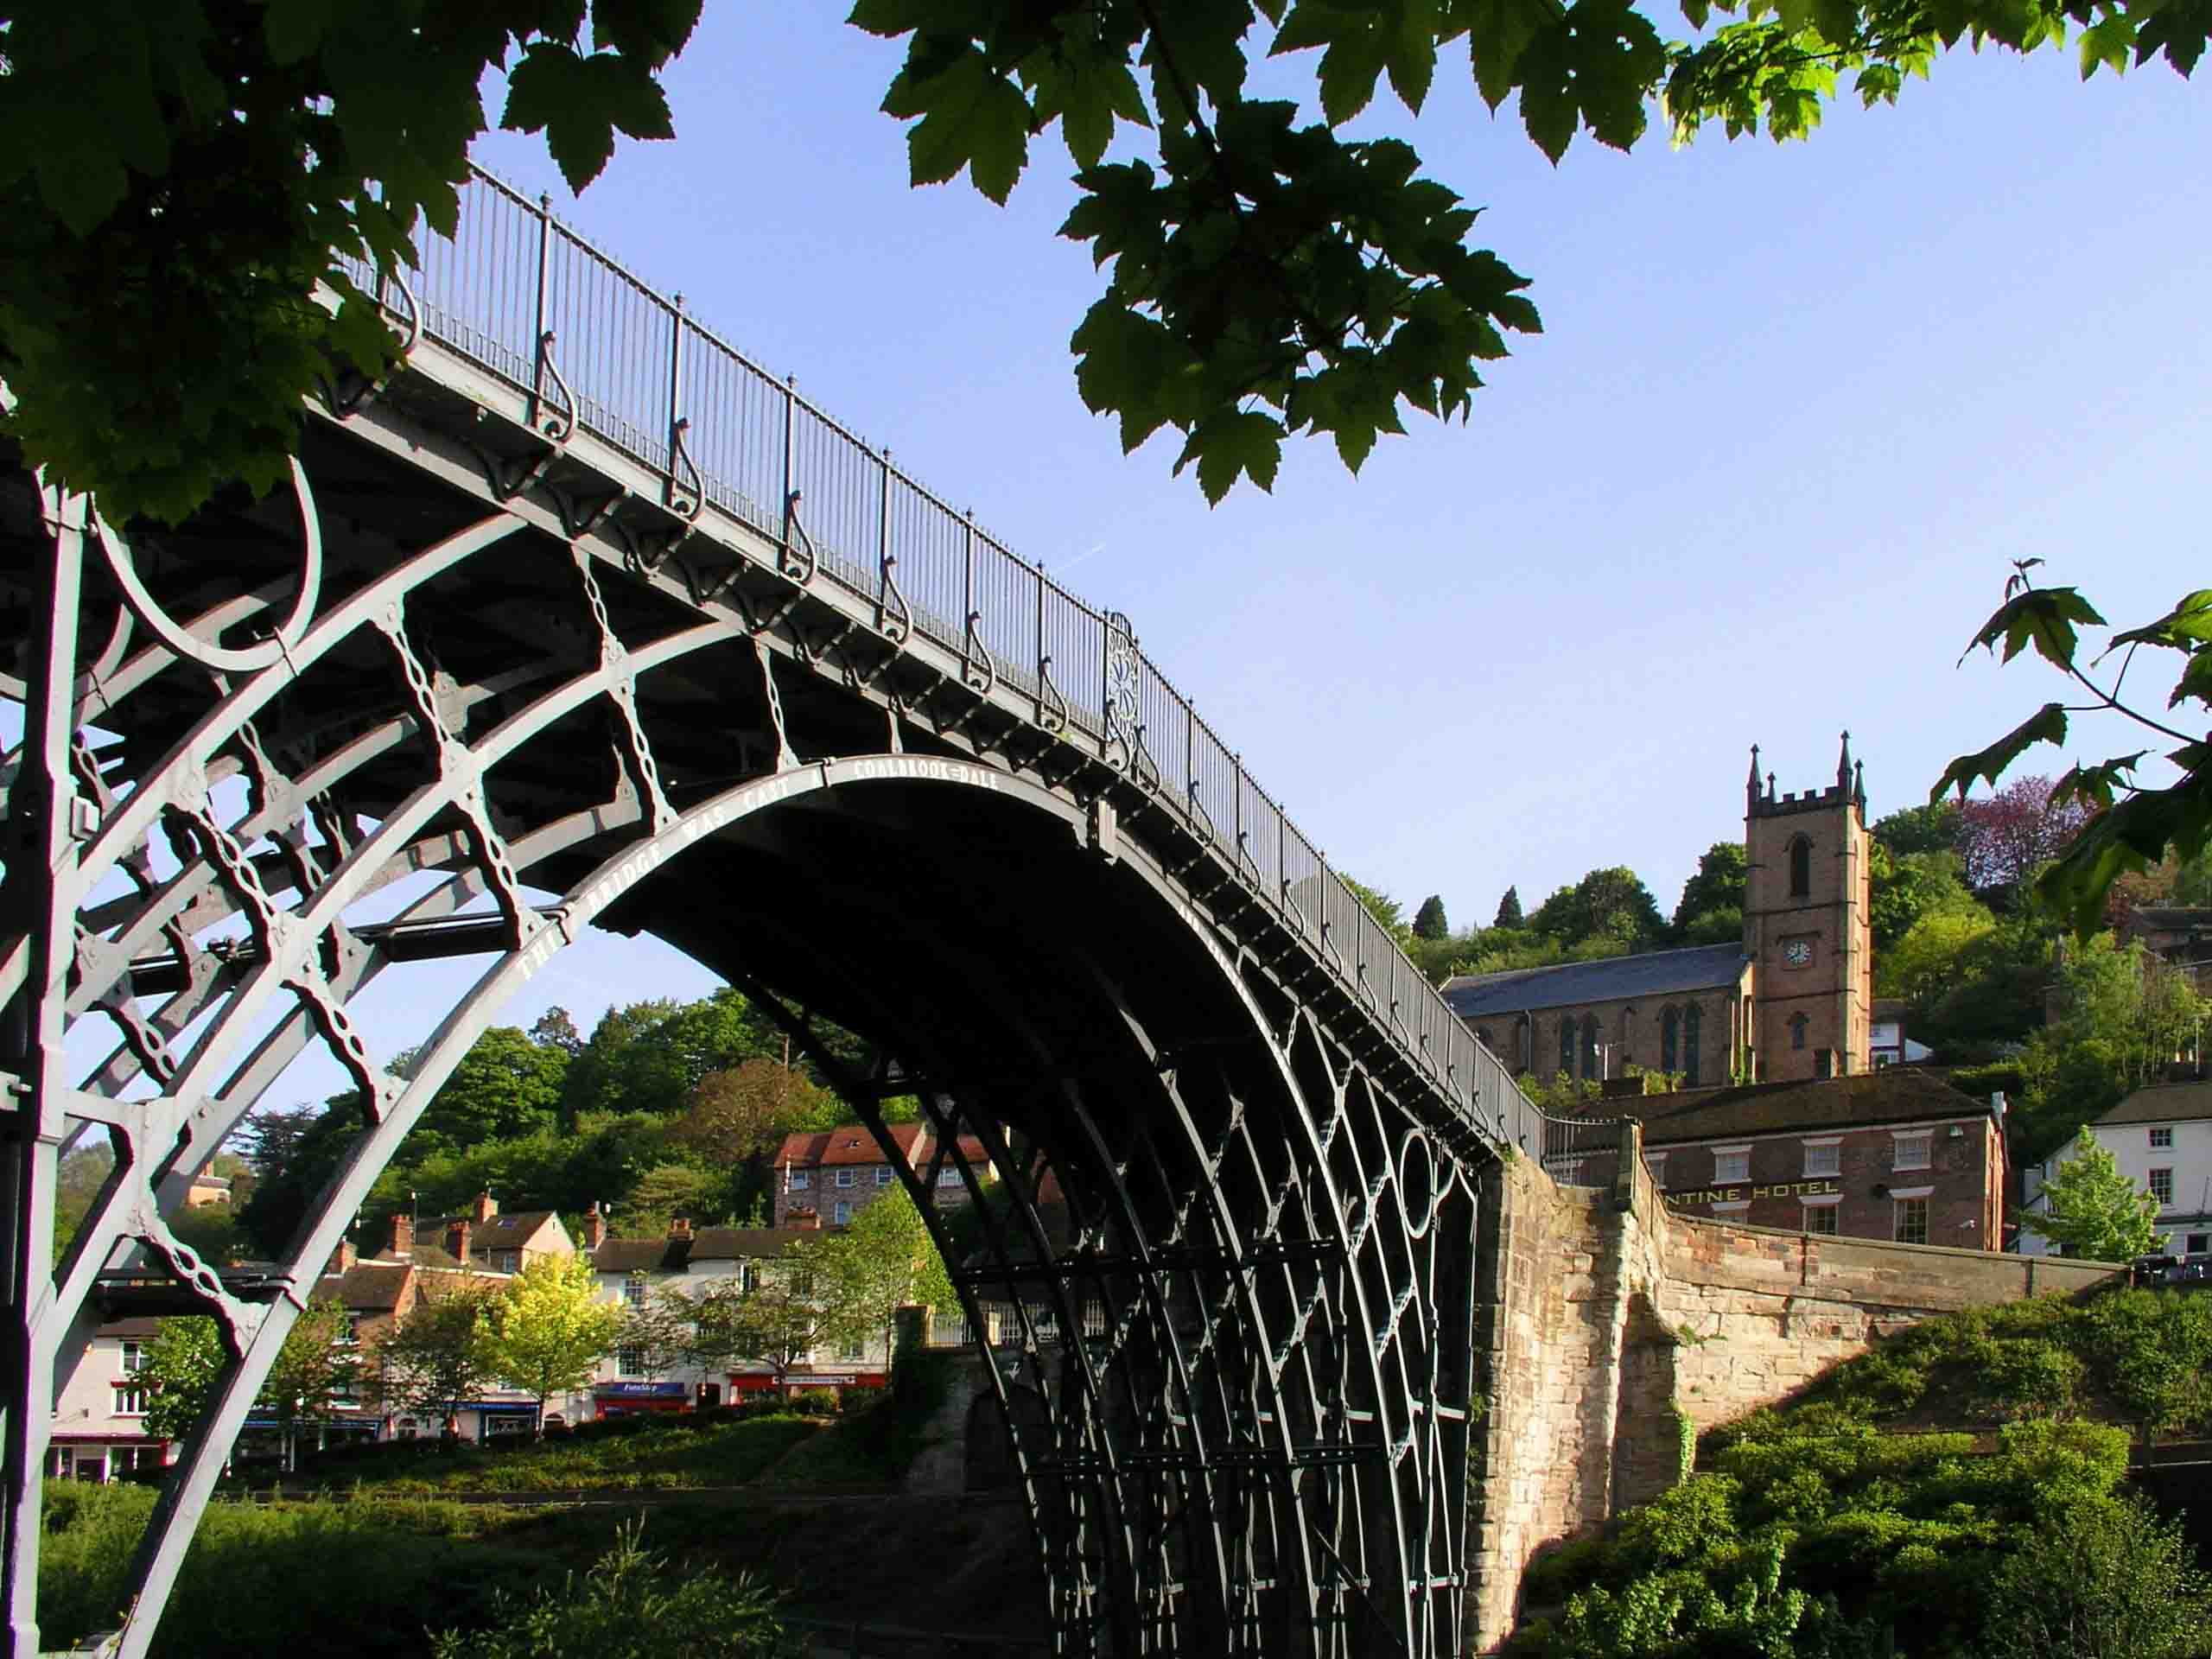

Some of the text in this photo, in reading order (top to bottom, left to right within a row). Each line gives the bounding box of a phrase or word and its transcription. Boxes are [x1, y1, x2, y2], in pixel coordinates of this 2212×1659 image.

[587, 842, 662, 914] BRIDGE
[682, 806, 725, 840] WAS
[744, 777, 788, 810] CAST
[1753, 1181, 1839, 1199] HOTEL
